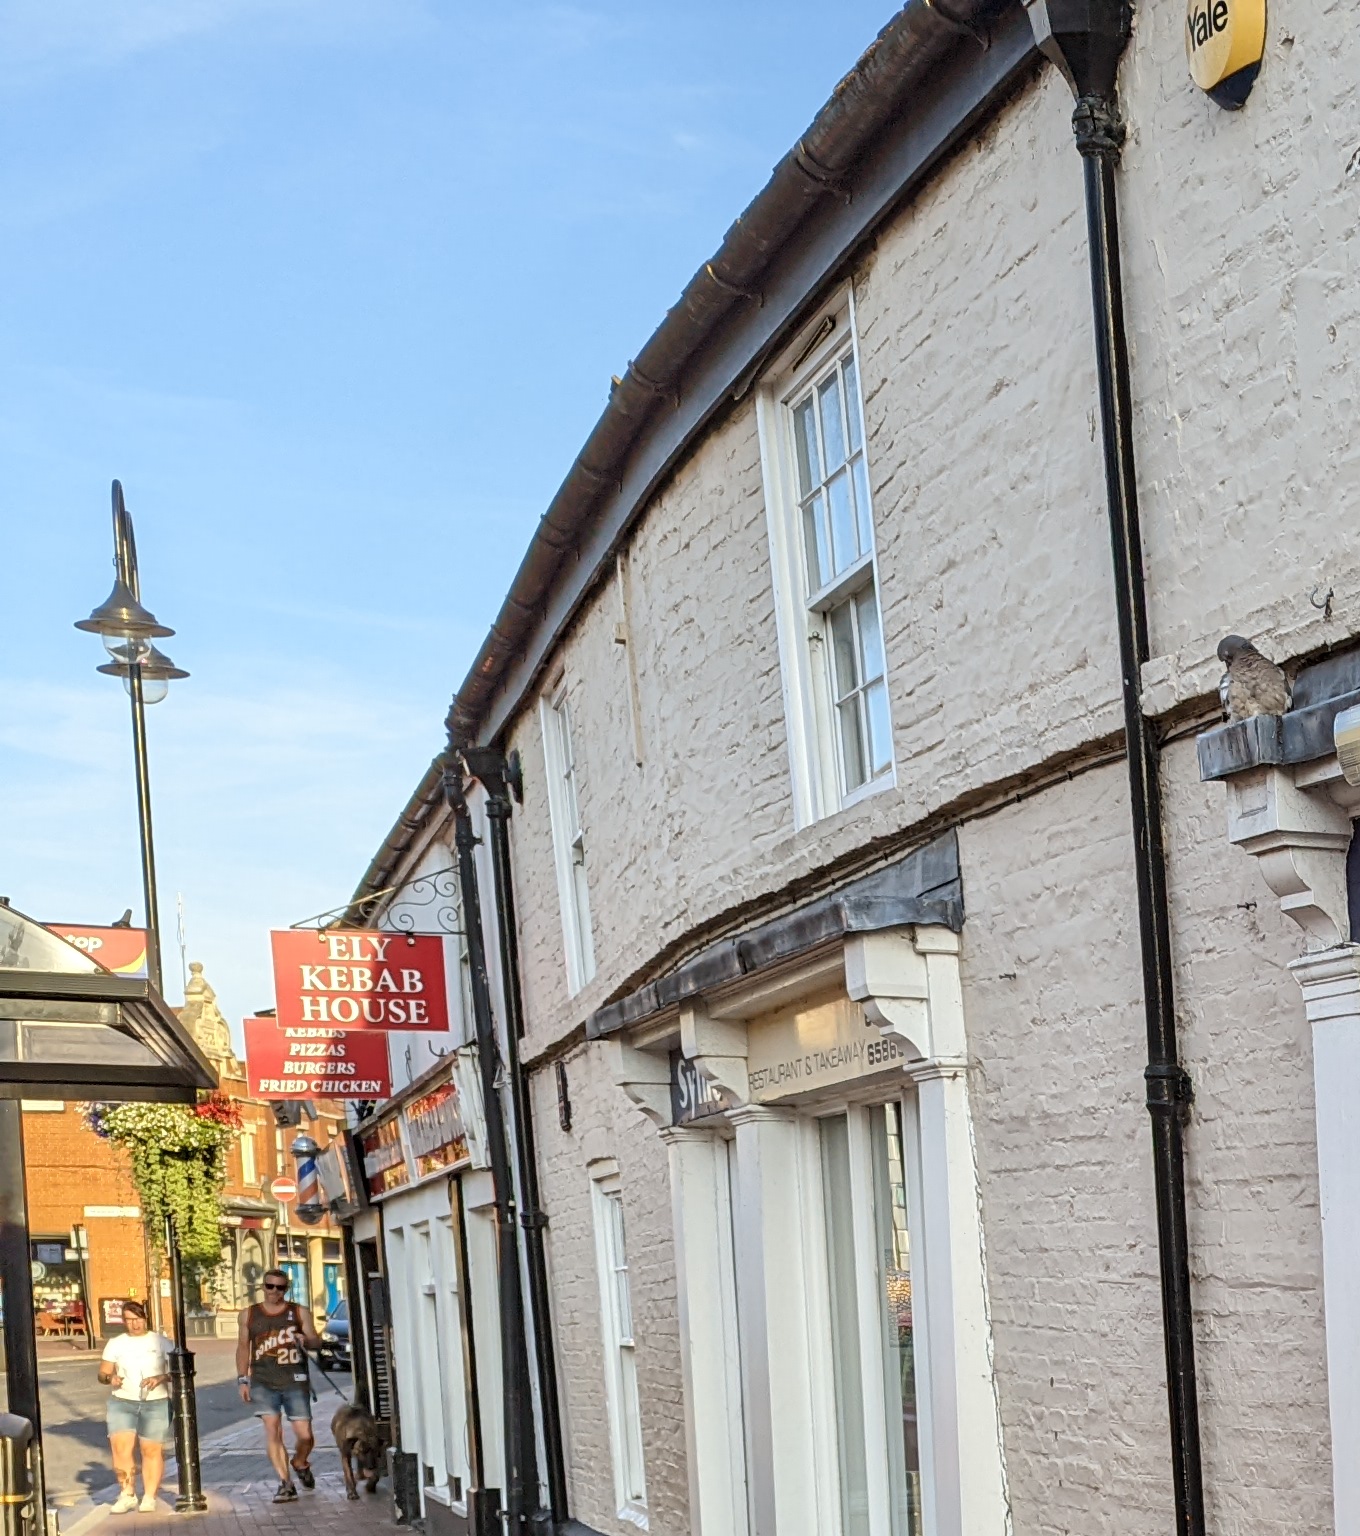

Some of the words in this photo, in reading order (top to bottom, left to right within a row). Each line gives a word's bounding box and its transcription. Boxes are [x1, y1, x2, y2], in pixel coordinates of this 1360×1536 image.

[1187, 0, 1228, 52] Yale
[326, 936, 392, 962] ELY
[300, 964, 424, 994] KEBAB
[300, 996, 429, 1024] HOUSE
[289, 1044, 346, 1057] PIZZAS
[283, 1062, 356, 1075] BURGERS
[748, 1058, 803, 1093] RESTAURANT
[805, 1056, 812, 1076] &
[814, 1039, 866, 1072] TAKEAWAY
[259, 1079, 308, 1093] FRIED
[310, 1080, 382, 1093] CHICKEN
[277, 1348, 300, 1365] 20
